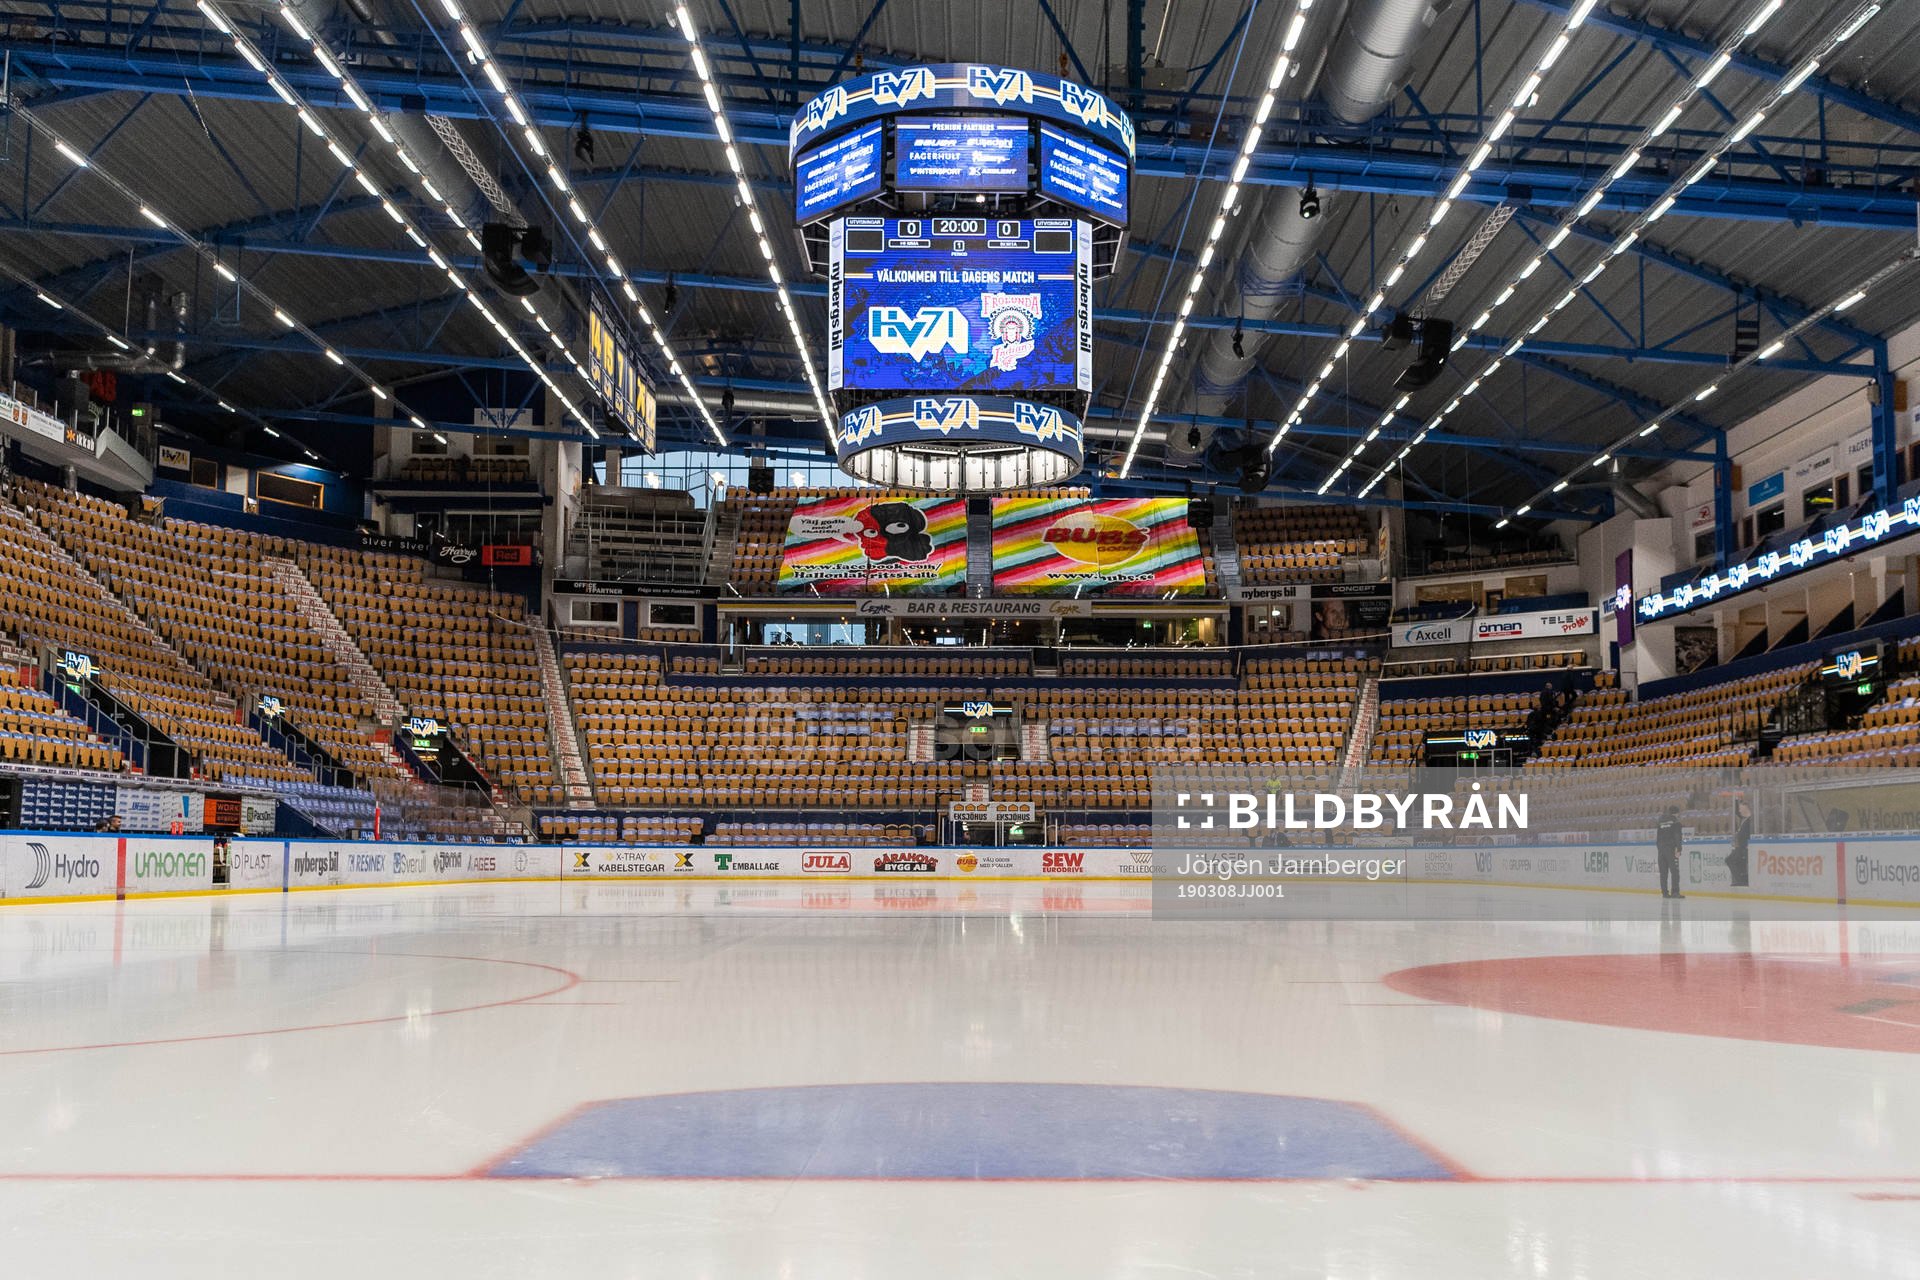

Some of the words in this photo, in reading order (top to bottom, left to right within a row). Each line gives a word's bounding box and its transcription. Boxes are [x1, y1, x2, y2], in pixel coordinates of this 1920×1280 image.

[909, 152, 960, 160] FAGERHULT
[907, 222, 916, 235] 0
[940, 220, 978, 233] 20:00
[1002, 223, 1011, 235] 0
[877, 268, 935, 283] VÄLKOMMEN
[939, 270, 960, 283] TILL
[962, 271, 1000, 283] DAGENS
[1002, 271, 1035, 284] MATCH
[831, 262, 842, 330] nybergs
[1080, 263, 1092, 332] nybergs
[831, 331, 842, 351] bil
[869, 307, 968, 361] HV71
[1080, 334, 1091, 353] bil
[913, 399, 979, 435] HV71
[1848, 438, 1872, 455] FAGERH
[1241, 588, 1282, 599] nybergs
[1284, 587, 1296, 597] bil
[907, 603, 935, 613] BAR
[939, 603, 948, 613] &
[951, 603, 1040, 613] RESTAURANG
[1541, 615, 1574, 624] TELE
[1415, 627, 1451, 641] Axcell
[1479, 622, 1522, 633] öman
[964, 702, 993, 719] HV71
[294, 854, 328, 876] nybergs
[328, 851, 339, 872] bil
[616, 852, 646, 861] X-TRAY
[804, 856, 849, 868] JULA
[1042, 853, 1084, 867] SEW
[1757, 851, 1824, 875] Passera
[55, 853, 99, 883] Hydro
[473, 857, 495, 871] AGES
[599, 864, 665, 872] KABELSTEGAR
[732, 862, 779, 870] EMBALLAGE
[1119, 865, 1167, 873] TRELLEBORG
